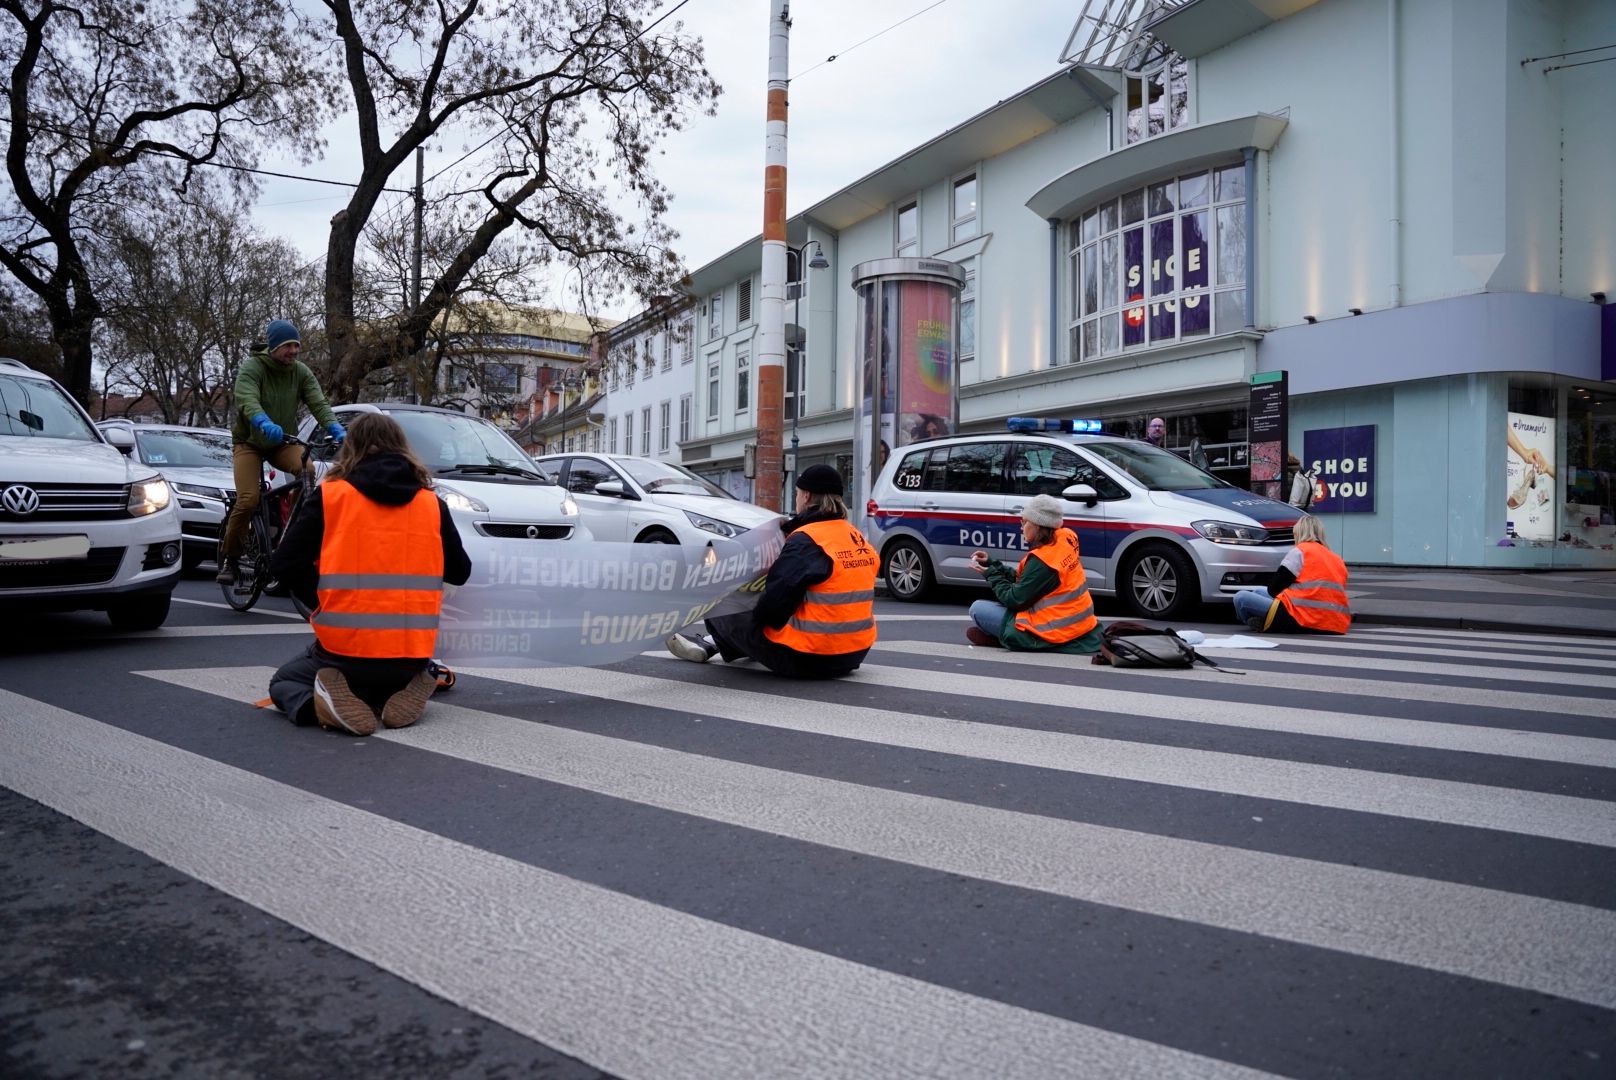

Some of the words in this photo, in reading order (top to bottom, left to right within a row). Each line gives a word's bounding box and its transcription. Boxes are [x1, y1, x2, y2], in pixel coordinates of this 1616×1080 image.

[1312, 457, 1368, 475] SHOE
[905, 474, 921, 488] 133
[1327, 481, 1368, 498] YOU
[959, 529, 1030, 550] POLIZE
